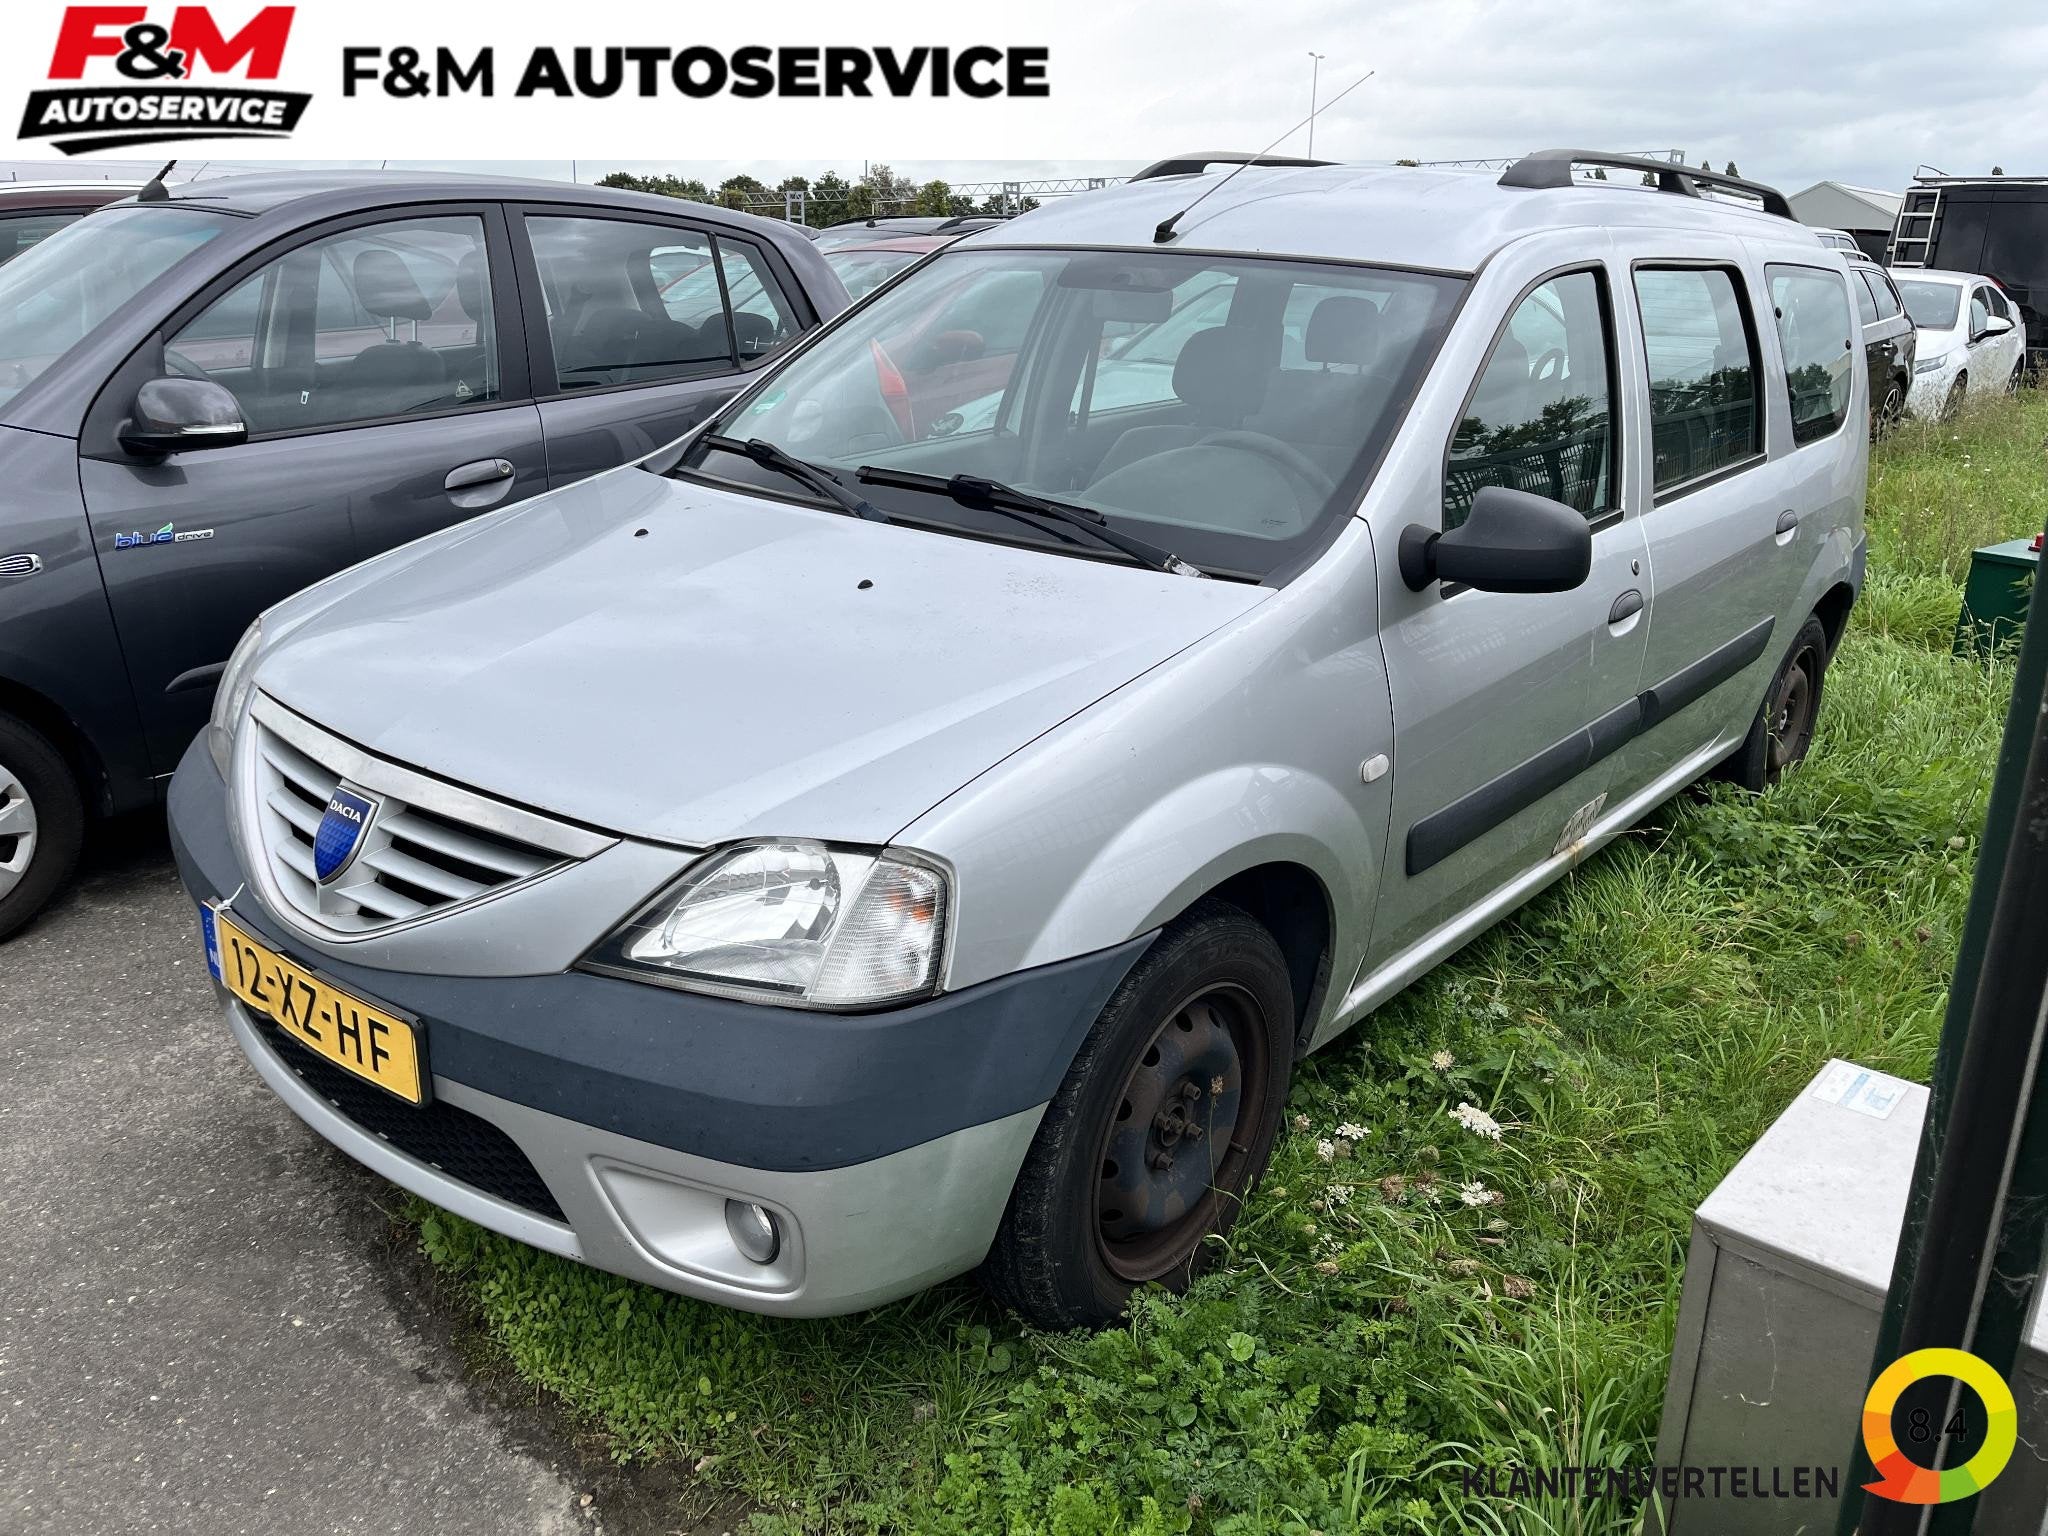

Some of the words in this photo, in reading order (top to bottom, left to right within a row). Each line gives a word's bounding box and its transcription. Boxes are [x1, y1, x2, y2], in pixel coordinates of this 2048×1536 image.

[177, 530, 212, 541] drive
[330, 799, 361, 823] DACIA
[231, 938, 390, 1072] 12-XZ-HF
